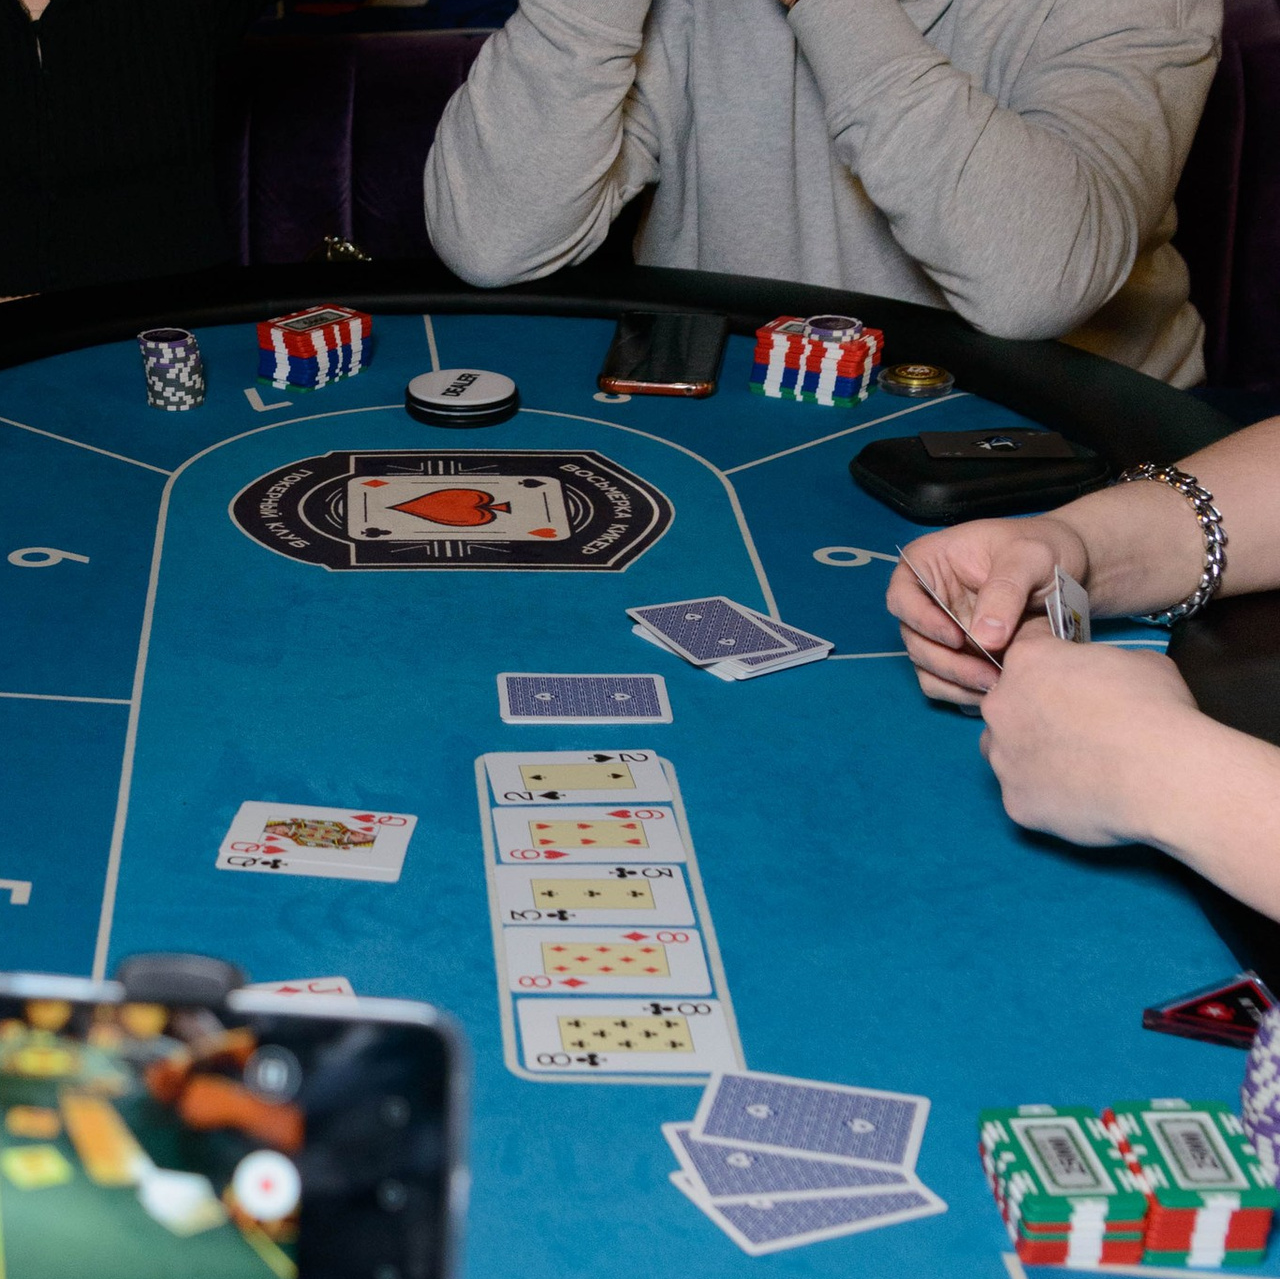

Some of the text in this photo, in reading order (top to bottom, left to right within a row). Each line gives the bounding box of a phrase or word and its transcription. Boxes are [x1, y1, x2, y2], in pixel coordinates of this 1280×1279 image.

[441, 373, 480, 397] DEALER
[559, 464, 633, 518] ВОСЬМЁРКА
[260, 468, 313, 549] ПОКЕРНЫЙ КЛУБ
[582, 523, 630, 555] КИКЕР
[619, 753, 649, 762] 2
[504, 791, 534, 801] 2
[373, 815, 407, 826] Q
[230, 841, 266, 853] Q
[227, 856, 263, 867] Q
[642, 868, 673, 878] 3
[510, 909, 542, 921] 3
[657, 931, 689, 943] 8
[308, 983, 343, 993] J
[519, 976, 552, 988] 8
[678, 1002, 712, 1015] 8
[537, 1052, 571, 1067] 8
